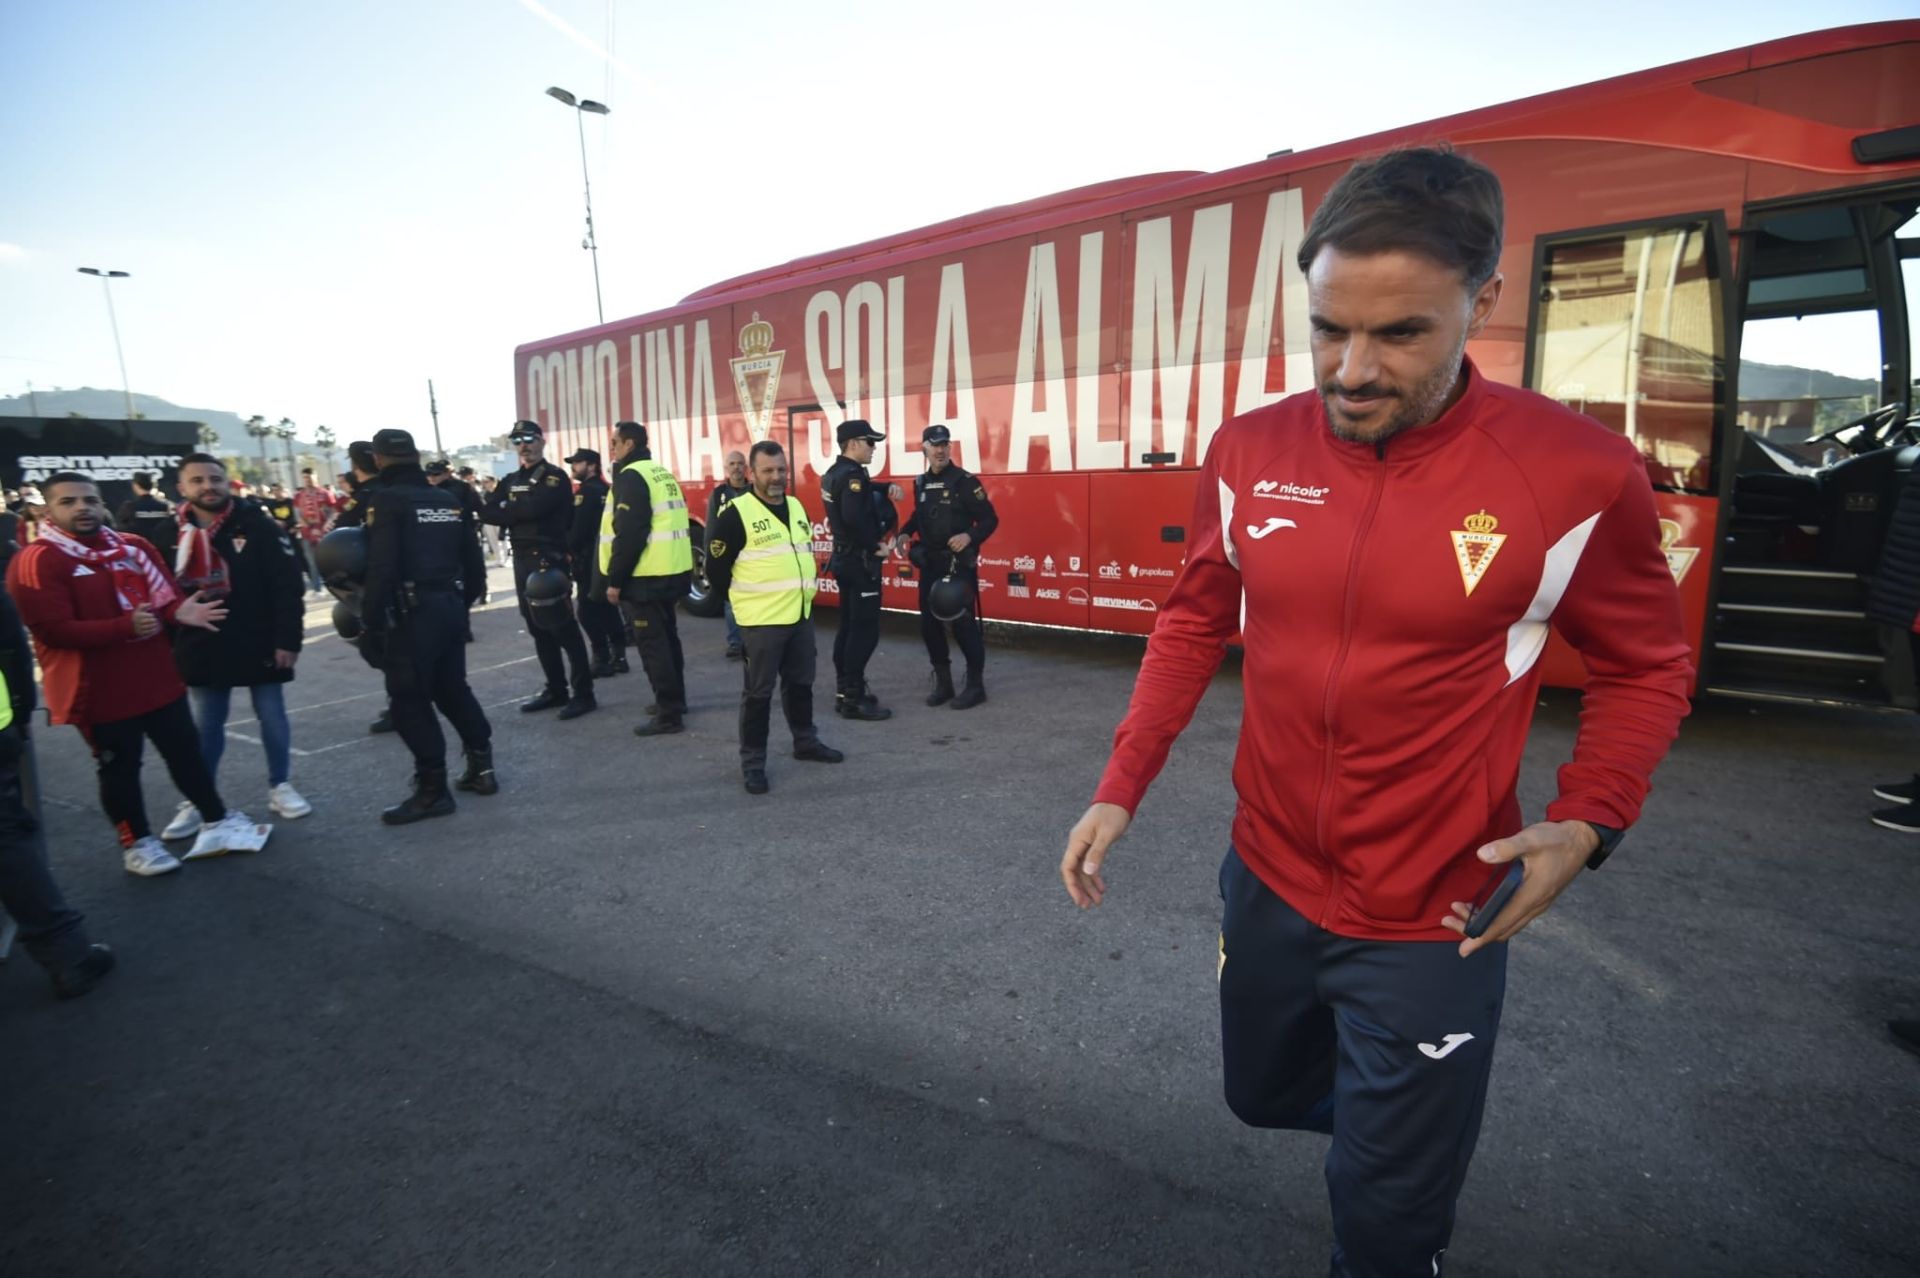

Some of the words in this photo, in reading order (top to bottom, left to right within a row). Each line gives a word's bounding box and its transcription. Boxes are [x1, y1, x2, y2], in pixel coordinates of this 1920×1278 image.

[528, 338, 621, 483] COMO
[630, 318, 726, 482] UNA
[804, 261, 982, 479] SOLA
[1007, 187, 1316, 472] ALMA
[740, 360, 772, 372] MURCIA
[752, 518, 771, 533] 507
[1099, 565, 1122, 577] CRC
